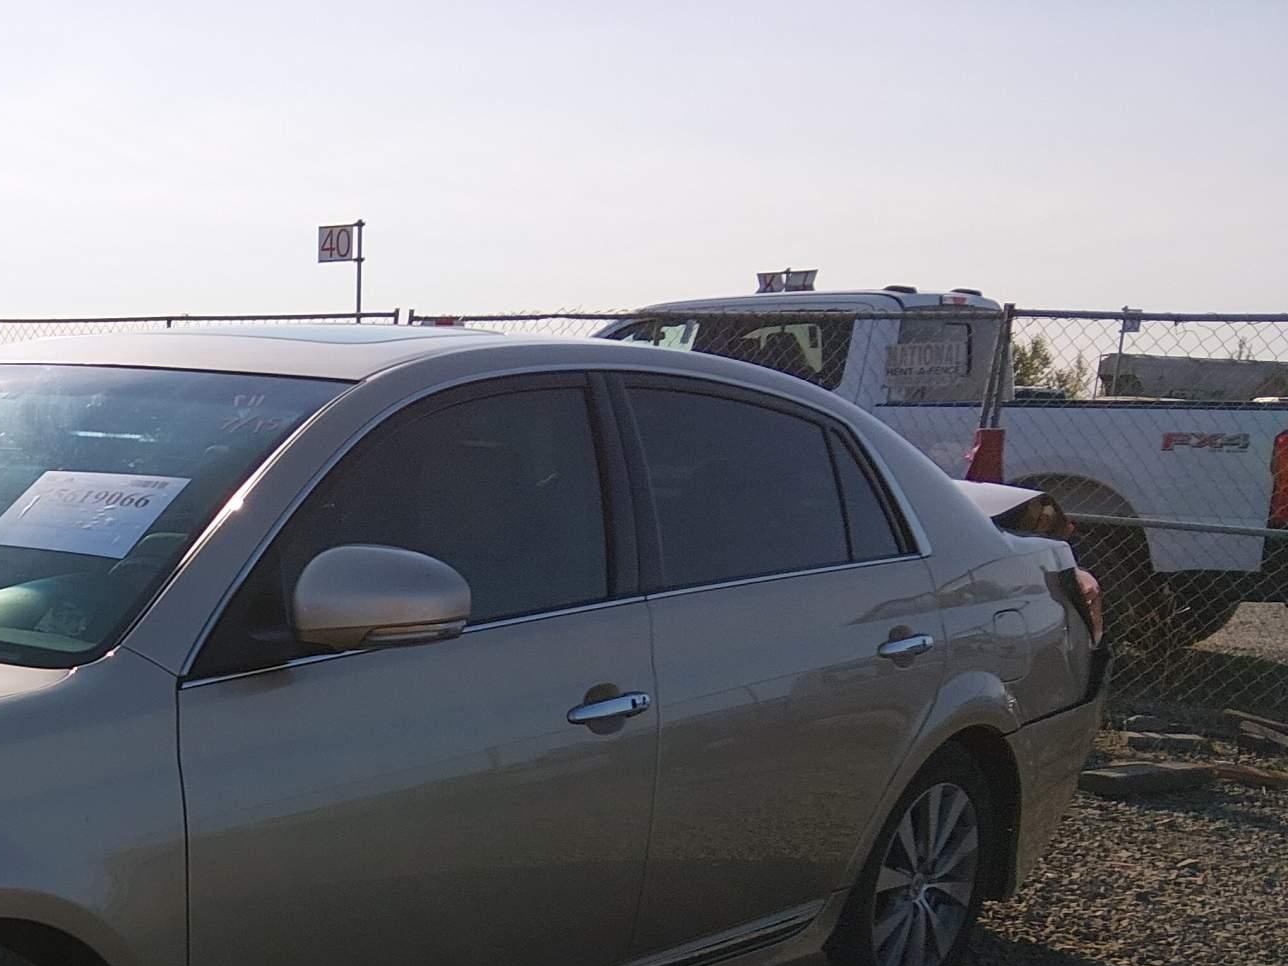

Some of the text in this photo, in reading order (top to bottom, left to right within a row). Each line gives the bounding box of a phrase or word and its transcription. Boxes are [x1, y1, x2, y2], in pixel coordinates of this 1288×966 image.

[320, 228, 352, 258] 40
[886, 344, 962, 366] NATIONAL
[1161, 432, 1250, 451] FX4
